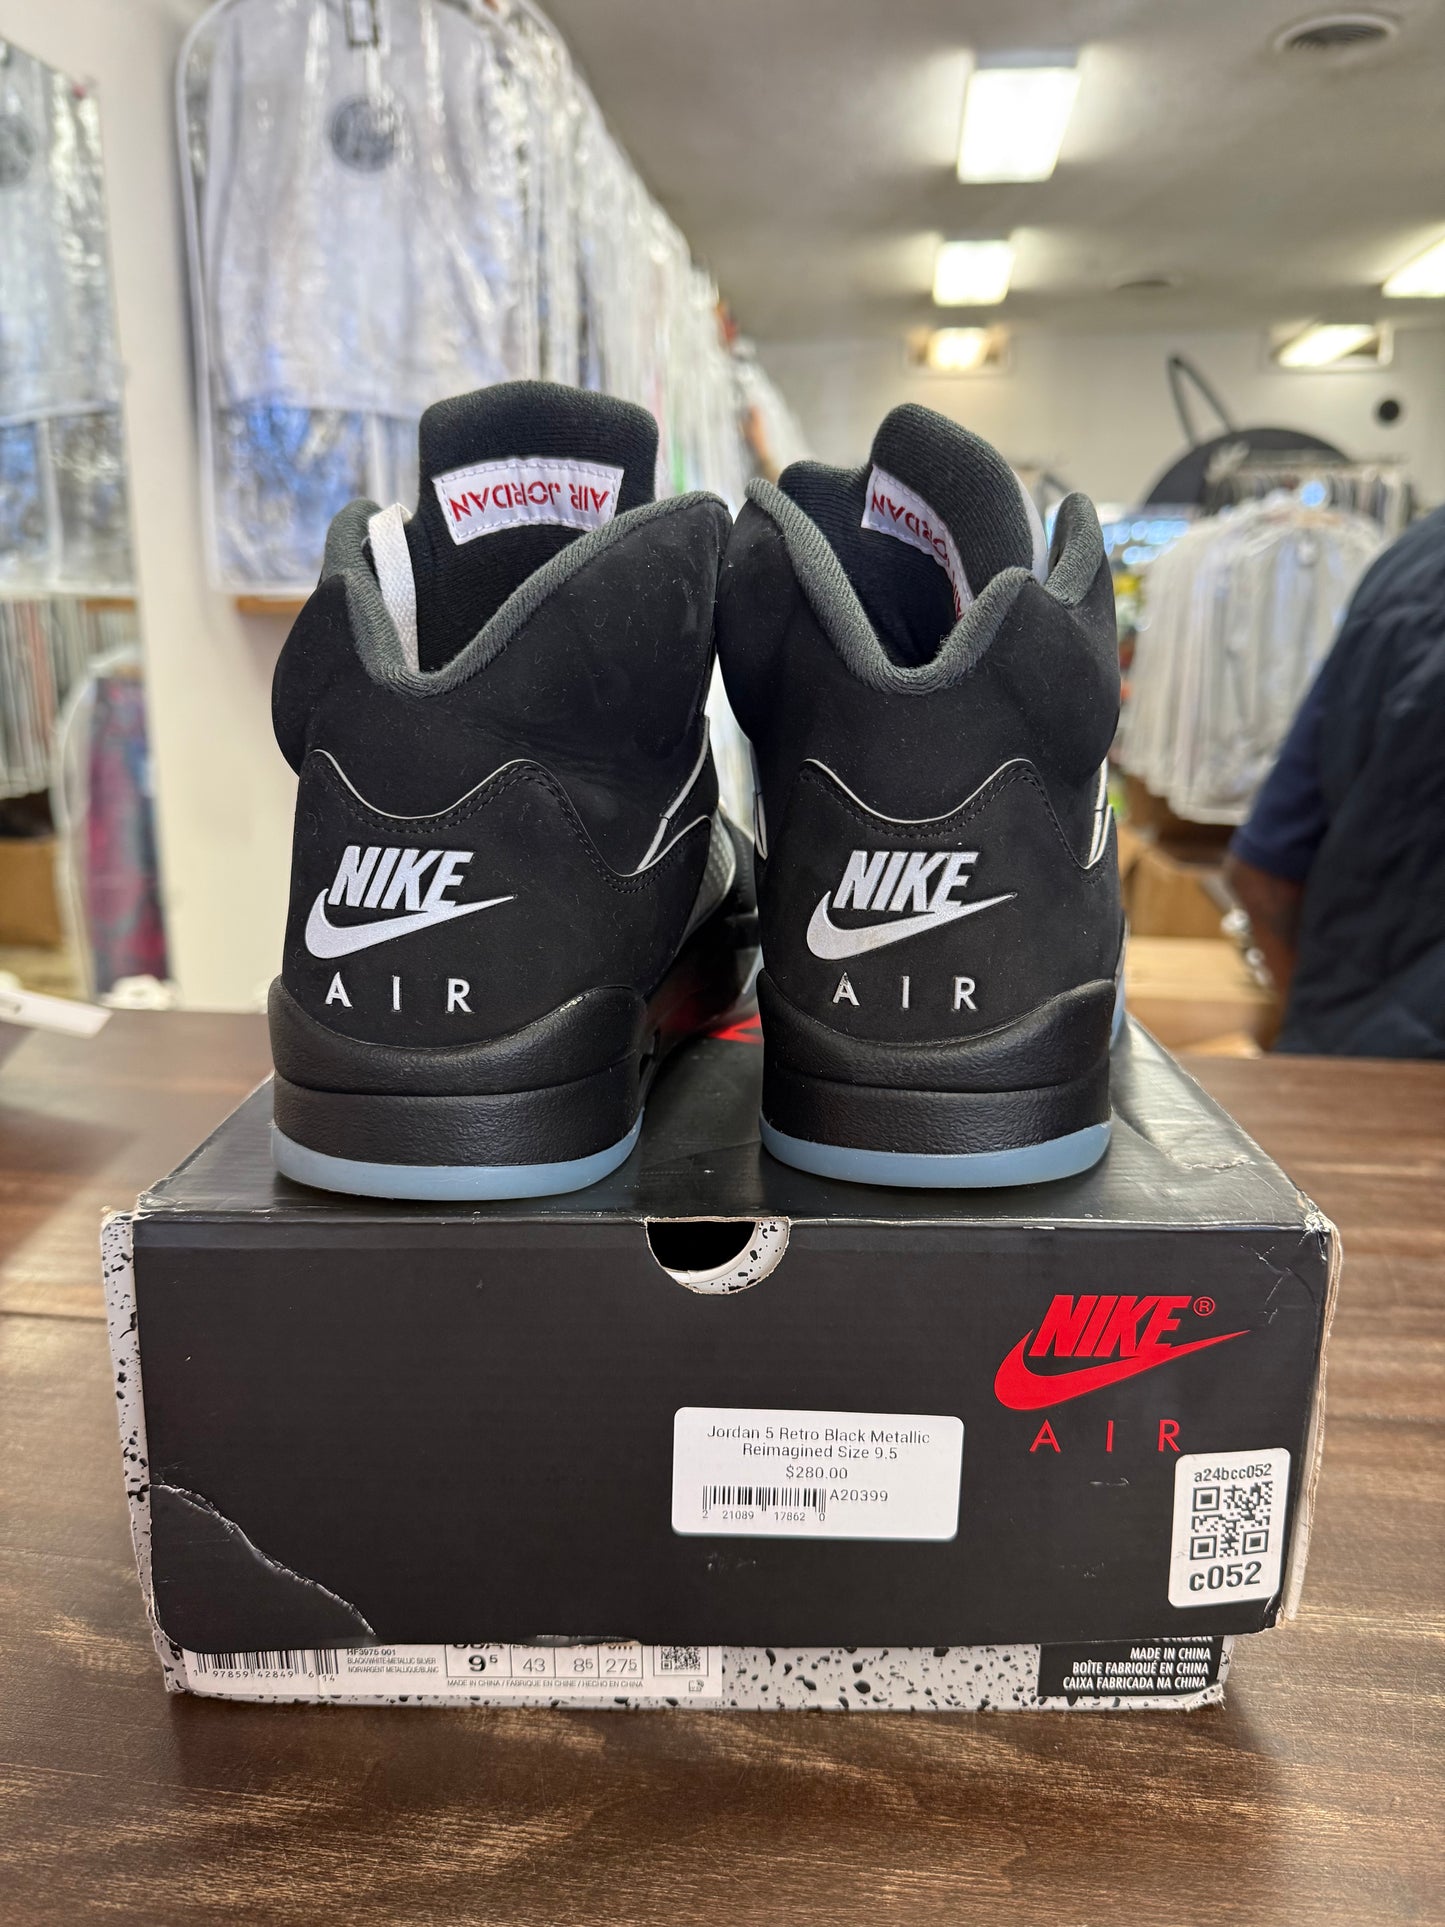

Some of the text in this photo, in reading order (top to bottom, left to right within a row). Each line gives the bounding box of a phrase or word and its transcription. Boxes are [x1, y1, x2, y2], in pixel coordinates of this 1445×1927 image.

[448, 480, 610, 522] AIR JORDAN
[327, 845, 474, 912] NIKE
[832, 849, 979, 913] NIKE
[324, 971, 473, 1013] AIR
[832, 972, 978, 1010] AIR
[1028, 1294, 1192, 1357] NIKE
[707, 1425, 930, 1444] Jordan 5 Retro Black Metallic
[1029, 1419, 1181, 1453] AIR
[742, 1443, 898, 1460] Reimagined Size 9.5
[785, 1464, 848, 1480] $280.00
[1193, 1463, 1273, 1484] a24bcc052
[829, 1489, 889, 1502] A20399
[722, 1510, 755, 1520] 21089
[774, 1511, 806, 1522] 17862
[1189, 1560, 1263, 1592] c052
[1130, 1647, 1212, 1660] MADE IN CHINA
[212, 1670, 249, 1678] 97859
[257, 1670, 294, 1678] 42849
[522, 1657, 546, 1673] 43
[1072, 1660, 1210, 1675] BOÎTE FABRIQUÉ EN CHINA
[447, 1679, 469, 1687] MADE
[469, 1679, 477, 1687] IN
[582, 1680, 608, 1688] HECHO
[609, 1680, 619, 1688] EN
[1062, 1676, 1206, 1690] CAIXA FABRICADA NA CHINA
